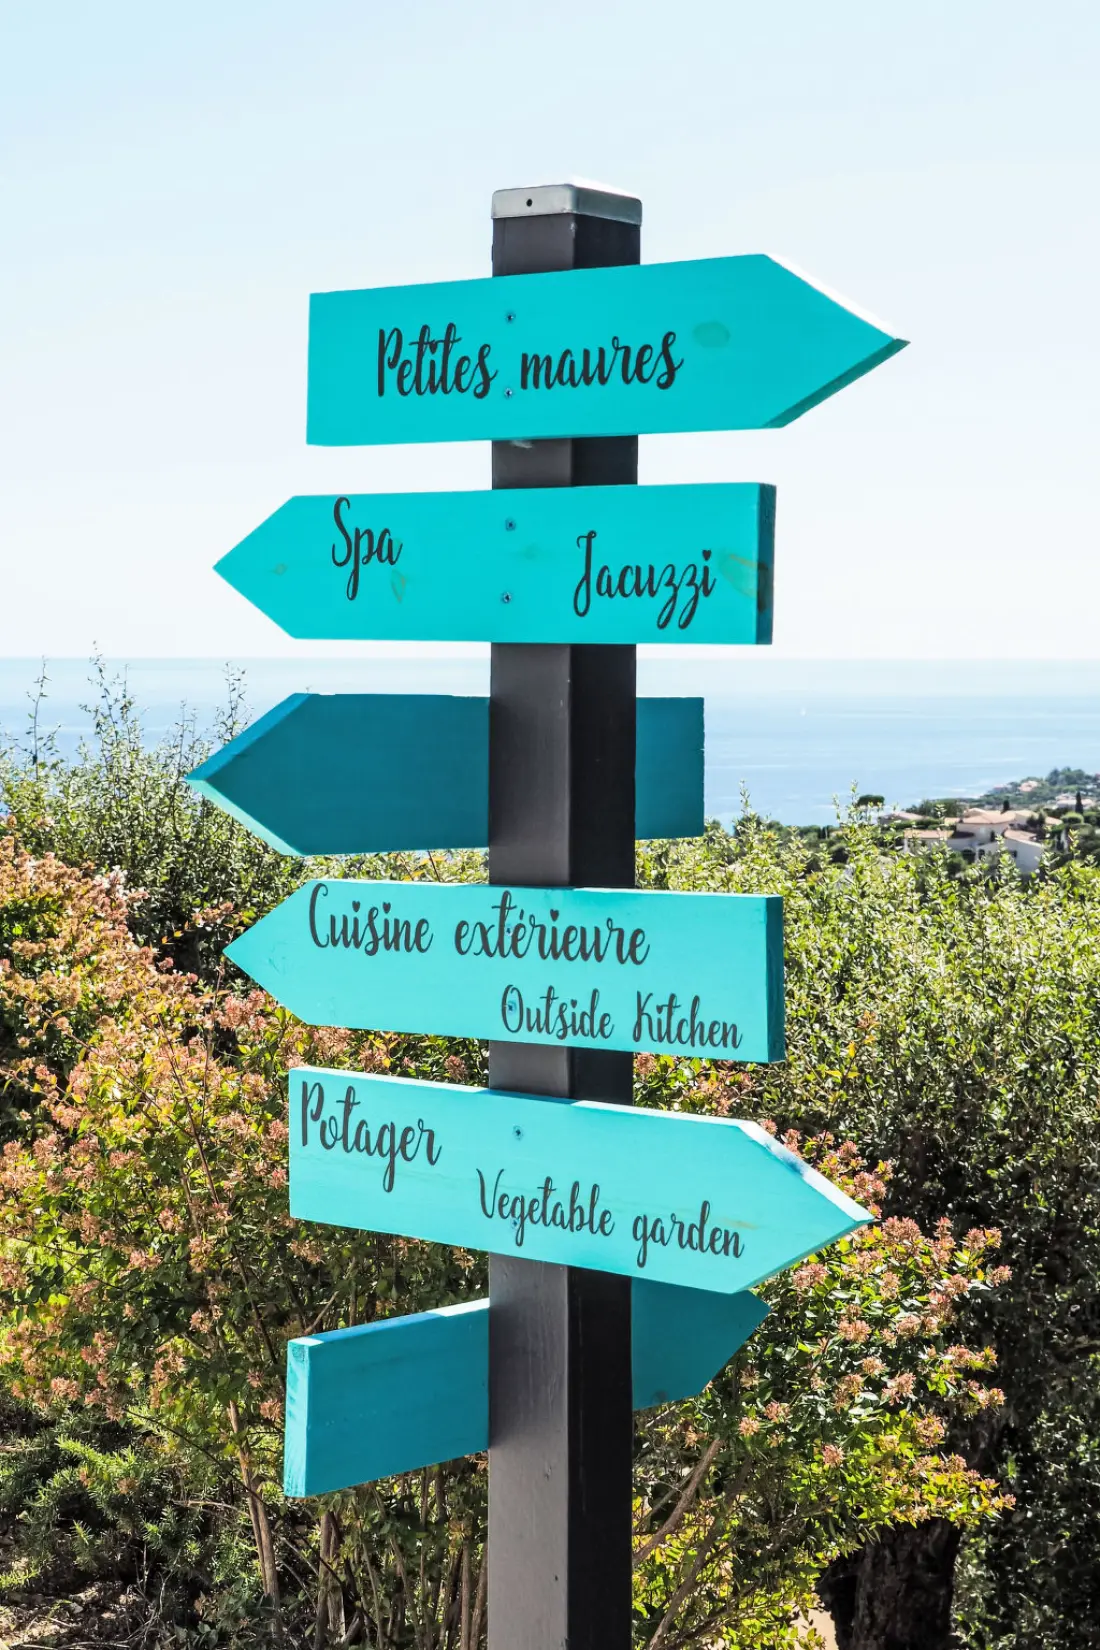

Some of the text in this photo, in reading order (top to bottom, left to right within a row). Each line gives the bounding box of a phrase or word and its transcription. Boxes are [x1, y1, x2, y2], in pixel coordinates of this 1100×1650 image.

[377, 322, 684, 399] Petites maures
[331, 497, 403, 601] Spa
[573, 530, 716, 630] Jacuzzi
[309, 882, 650, 965] Cuisine extérieure
[501, 984, 743, 1049] Outside Kitchen
[301, 1081, 443, 1193] Potager
[477, 1170, 744, 1268] Vegetable garden
